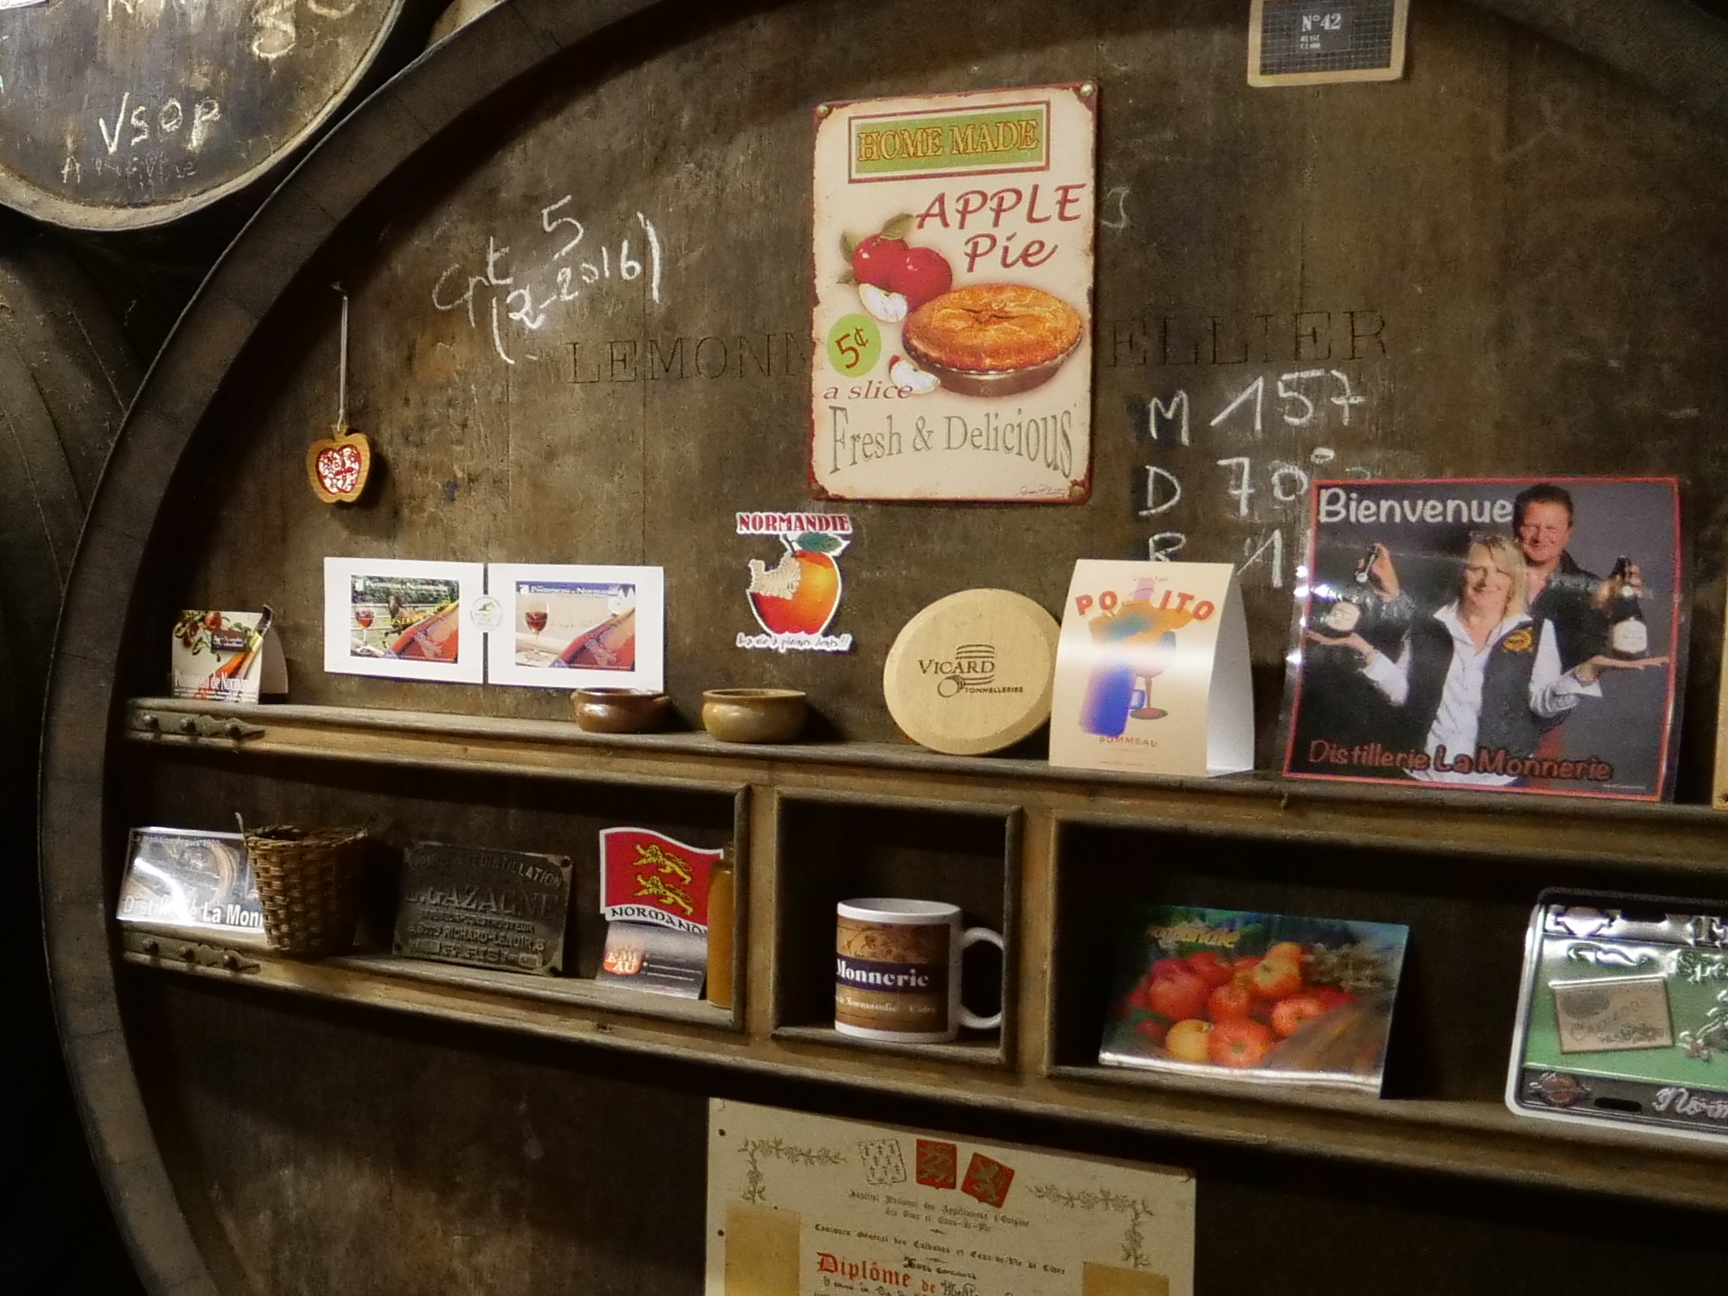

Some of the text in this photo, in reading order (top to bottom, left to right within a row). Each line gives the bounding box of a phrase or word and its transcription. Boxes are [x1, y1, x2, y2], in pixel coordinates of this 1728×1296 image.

[1302, 13, 1341, 32] N°42
[99, 92, 221, 154] VSOP
[858, 119, 1039, 162] HOME MADE
[542, 195, 584, 259] 5
[916, 182, 1088, 230] APPLE
[963, 230, 1059, 273] Pie
[835, 325, 871, 369] 5¢
[822, 379, 913, 401] a slice
[1147, 369, 1368, 446] M 157
[829, 403, 1077, 480] Fresh & Delicious
[1140, 465, 1182, 516] D
[1316, 486, 1515, 525] Bienvenue
[738, 513, 851, 532] NORMANDIE
[918, 658, 996, 676] VICARD
[964, 685, 1024, 695] TONNELLERIES
[1098, 734, 1158, 748] POMMEAU
[1308, 739, 1614, 783] Distillerie La Monnerie
[203, 902, 222, 924] La
[835, 957, 930, 988] Monnerie
[815, 1250, 937, 1294] Diplôme de
